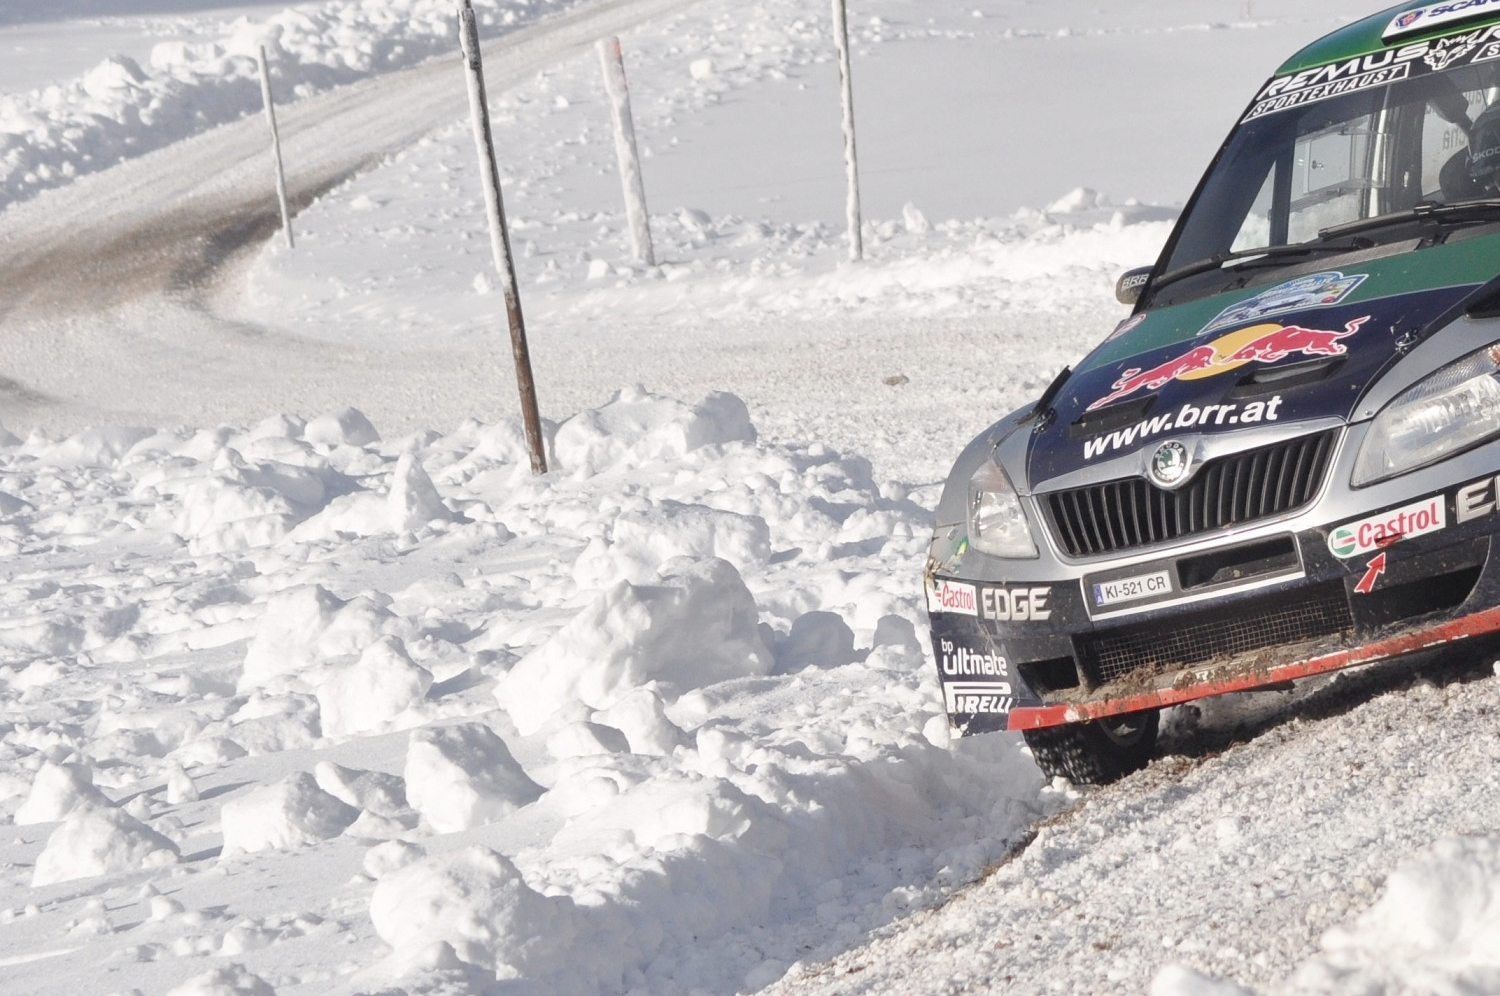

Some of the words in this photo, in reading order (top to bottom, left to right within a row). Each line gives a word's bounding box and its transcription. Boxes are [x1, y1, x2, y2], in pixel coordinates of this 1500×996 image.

[1256, 41, 1429, 100] REMUS
[1251, 66, 1403, 117] SPORTEXHAUST
[1083, 395, 1282, 459] www.brr.at
[1358, 502, 1440, 548] Castrol
[942, 584, 976, 611] Castrol
[981, 586, 1052, 621] EDGE
[1105, 580, 1143, 599] KI-521
[1147, 576, 1166, 591] CR
[941, 638, 954, 655] bp
[943, 647, 1008, 676] ultimate
[943, 681, 1013, 714] PIRELLI
